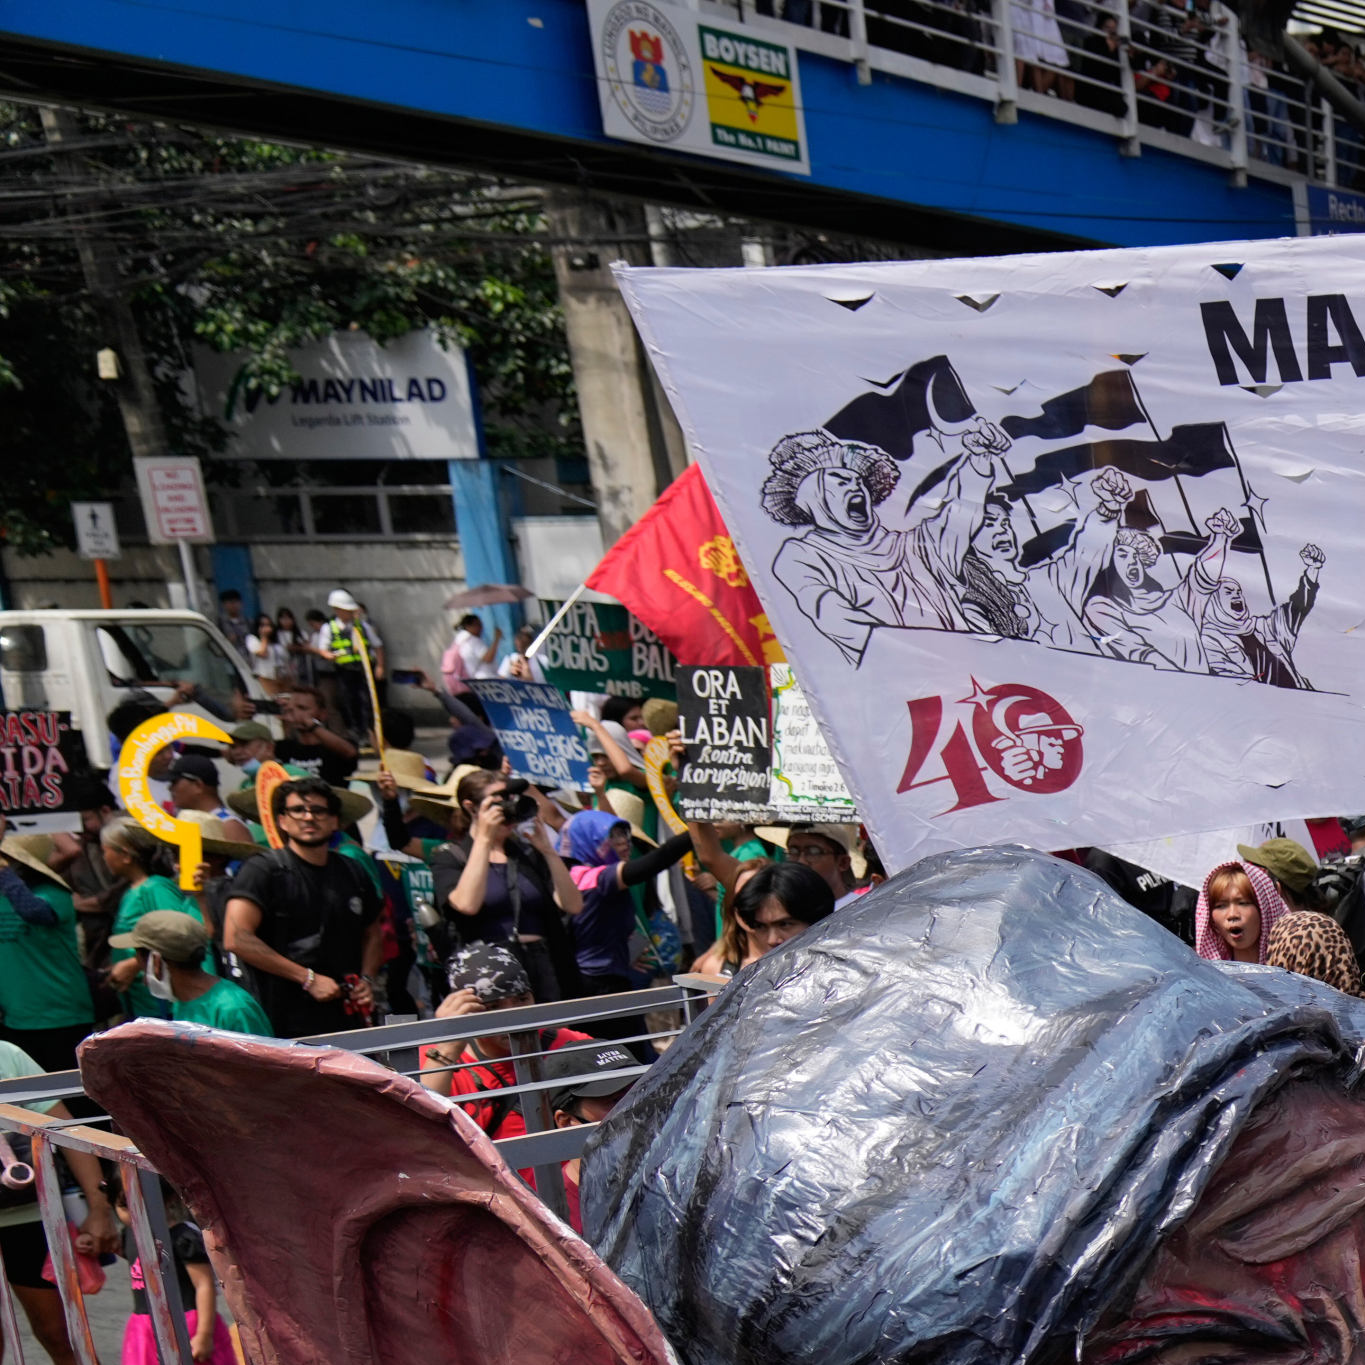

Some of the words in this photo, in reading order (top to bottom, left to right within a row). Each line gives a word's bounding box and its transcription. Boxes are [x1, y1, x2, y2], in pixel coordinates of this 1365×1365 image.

[702, 33, 787, 77] BOYSEN
[715, 127, 736, 145] The
[766, 139, 796, 157] PAINT
[1327, 193, 1365, 221] Recto
[291, 376, 448, 405] MAYNILAD
[292, 412, 340, 430] Legarda
[342, 412, 365, 427] Lift
[546, 635, 610, 673] BIGAS
[692, 669, 742, 700] ORA
[708, 699, 730, 716] ET
[679, 716, 769, 749] LABAN
